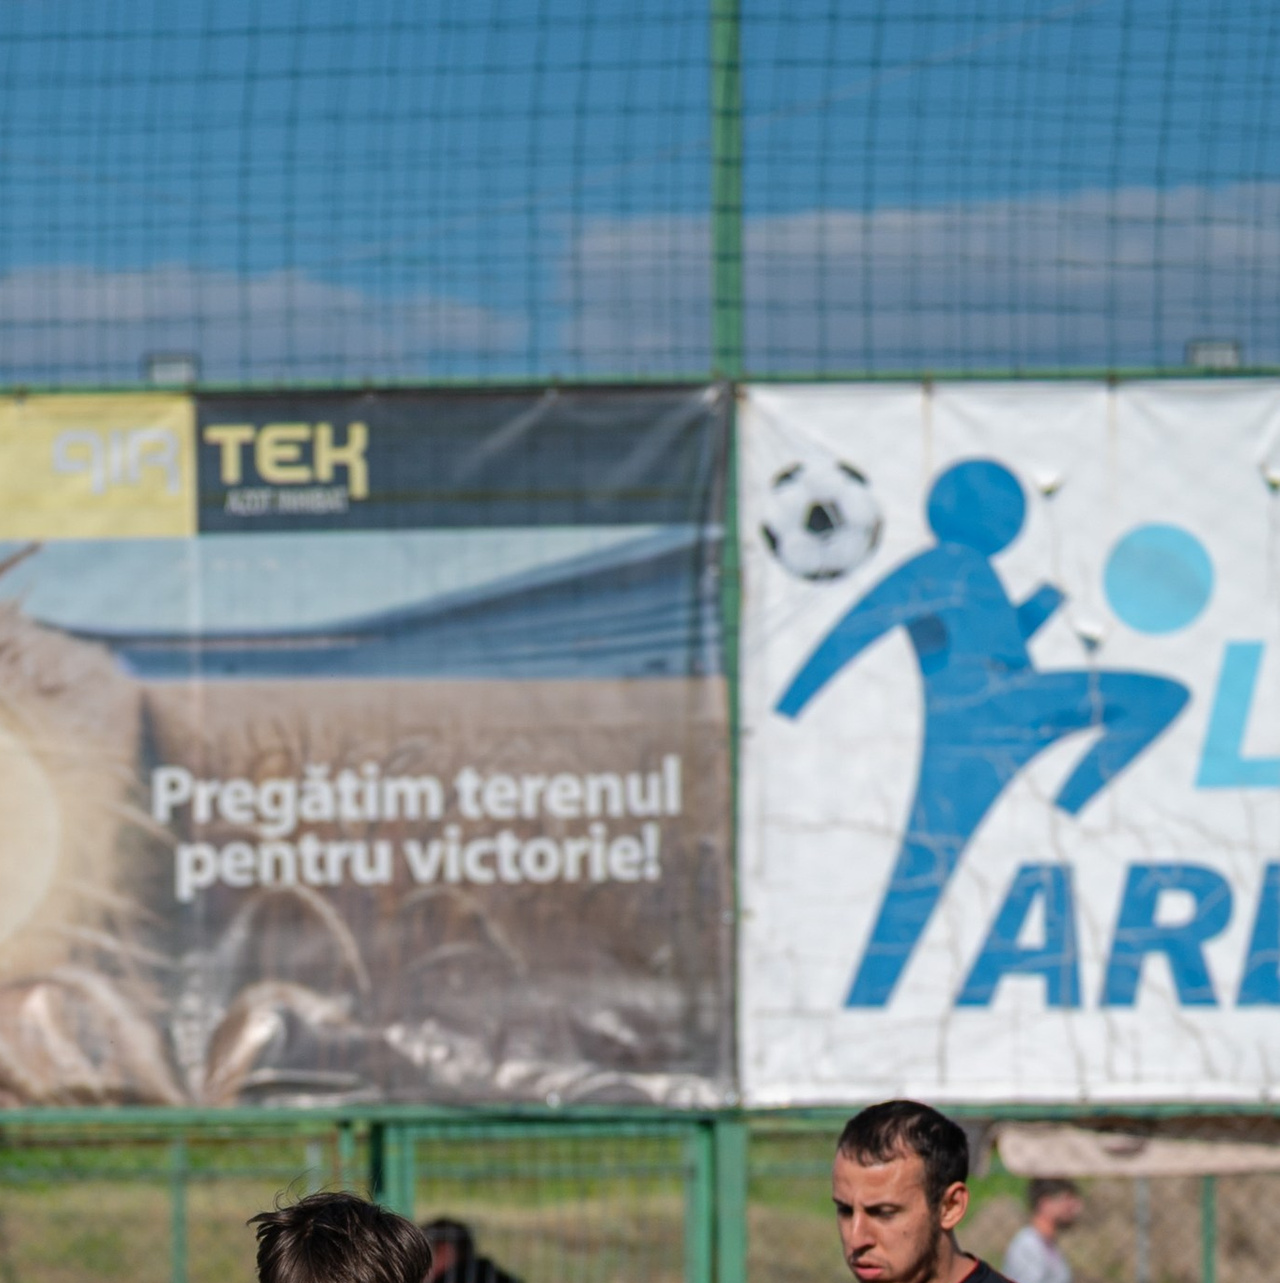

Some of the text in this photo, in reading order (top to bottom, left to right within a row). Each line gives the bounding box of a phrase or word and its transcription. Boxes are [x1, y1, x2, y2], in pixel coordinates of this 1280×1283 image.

[203, 422, 369, 500] TEK
[150, 754, 683, 838] Pregătim terenul
[175, 821, 661, 902] pentru victorie!
